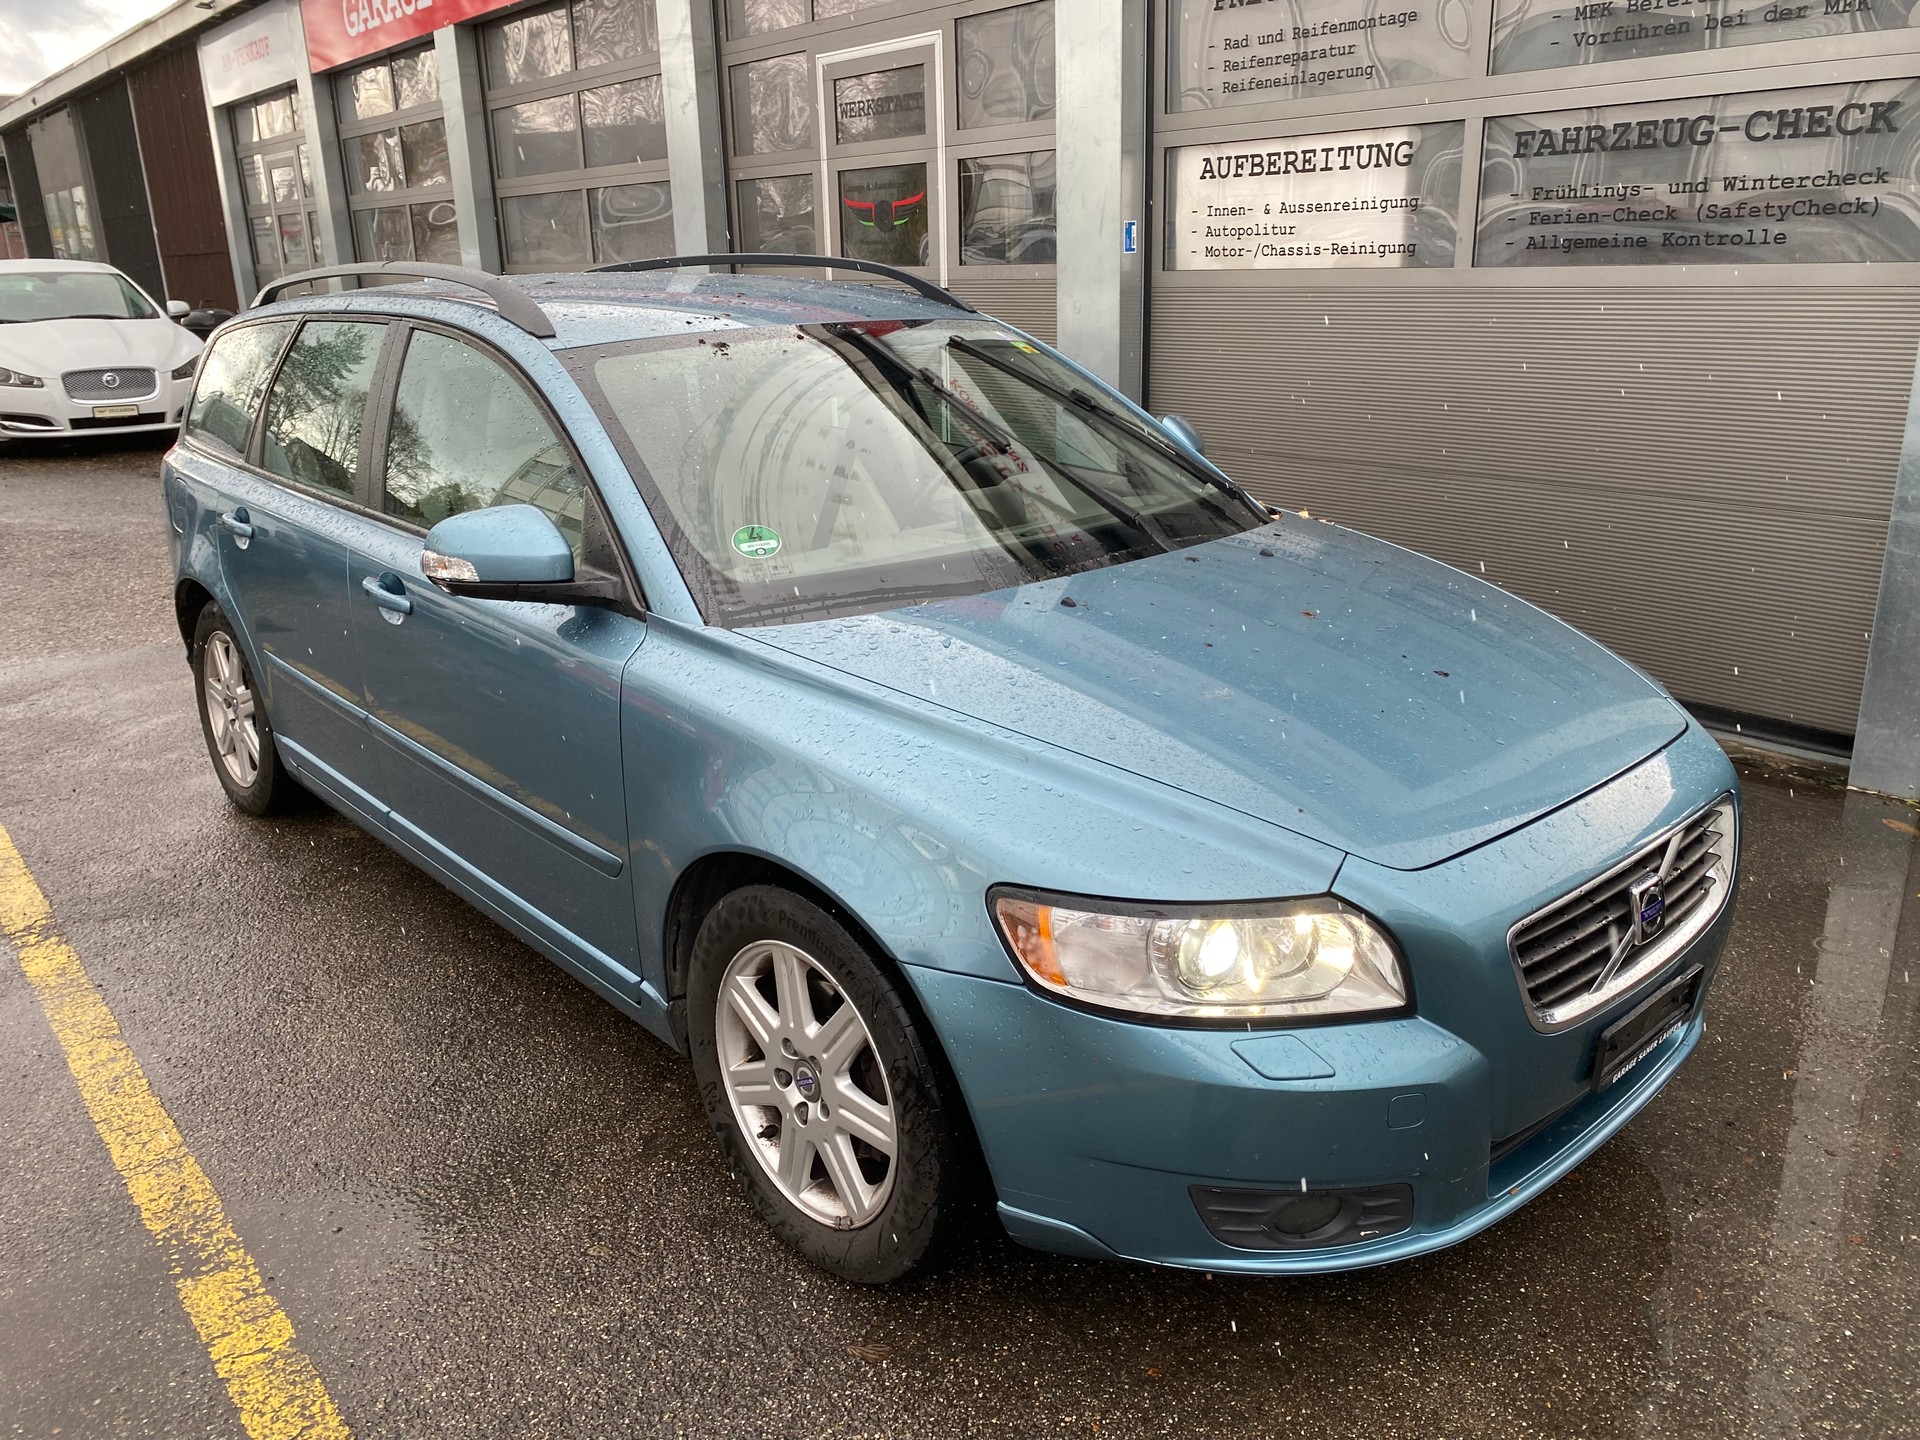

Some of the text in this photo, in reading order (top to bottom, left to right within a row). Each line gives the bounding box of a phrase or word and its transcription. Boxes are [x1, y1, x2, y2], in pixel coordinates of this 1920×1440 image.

[1572, 0, 1872, 47] Vorführen bei der MFK
[1573, 2, 1613, 21] MFK
[1223, 10, 1418, 51] Rad und Reifenmontage
[1222, 41, 1356, 73] Reifenreparatur
[1221, 62, 1375, 95] Reifeneinlagerung
[838, 91, 923, 120] WERKSTATT
[1512, 100, 1901, 160] FAHRZEUG-CHECK
[1199, 140, 1414, 181] AUFBEREITUNG
[1532, 167, 1889, 203] Frühlings- und Wintercheck
[1206, 195, 1420, 218] Innen- & Aussenreinigung
[1529, 195, 1882, 227] Ferien-Check (SafetyCheck)
[1205, 223, 1297, 242] Autopolitur
[1526, 229, 1787, 253] Allgemeine Kontrolle
[1205, 241, 1418, 260] Motor-/Chassis-Reinigung
[1612, 1056, 1638, 1083] GARAGE
[1658, 1020, 1683, 1044] LAUFEN
